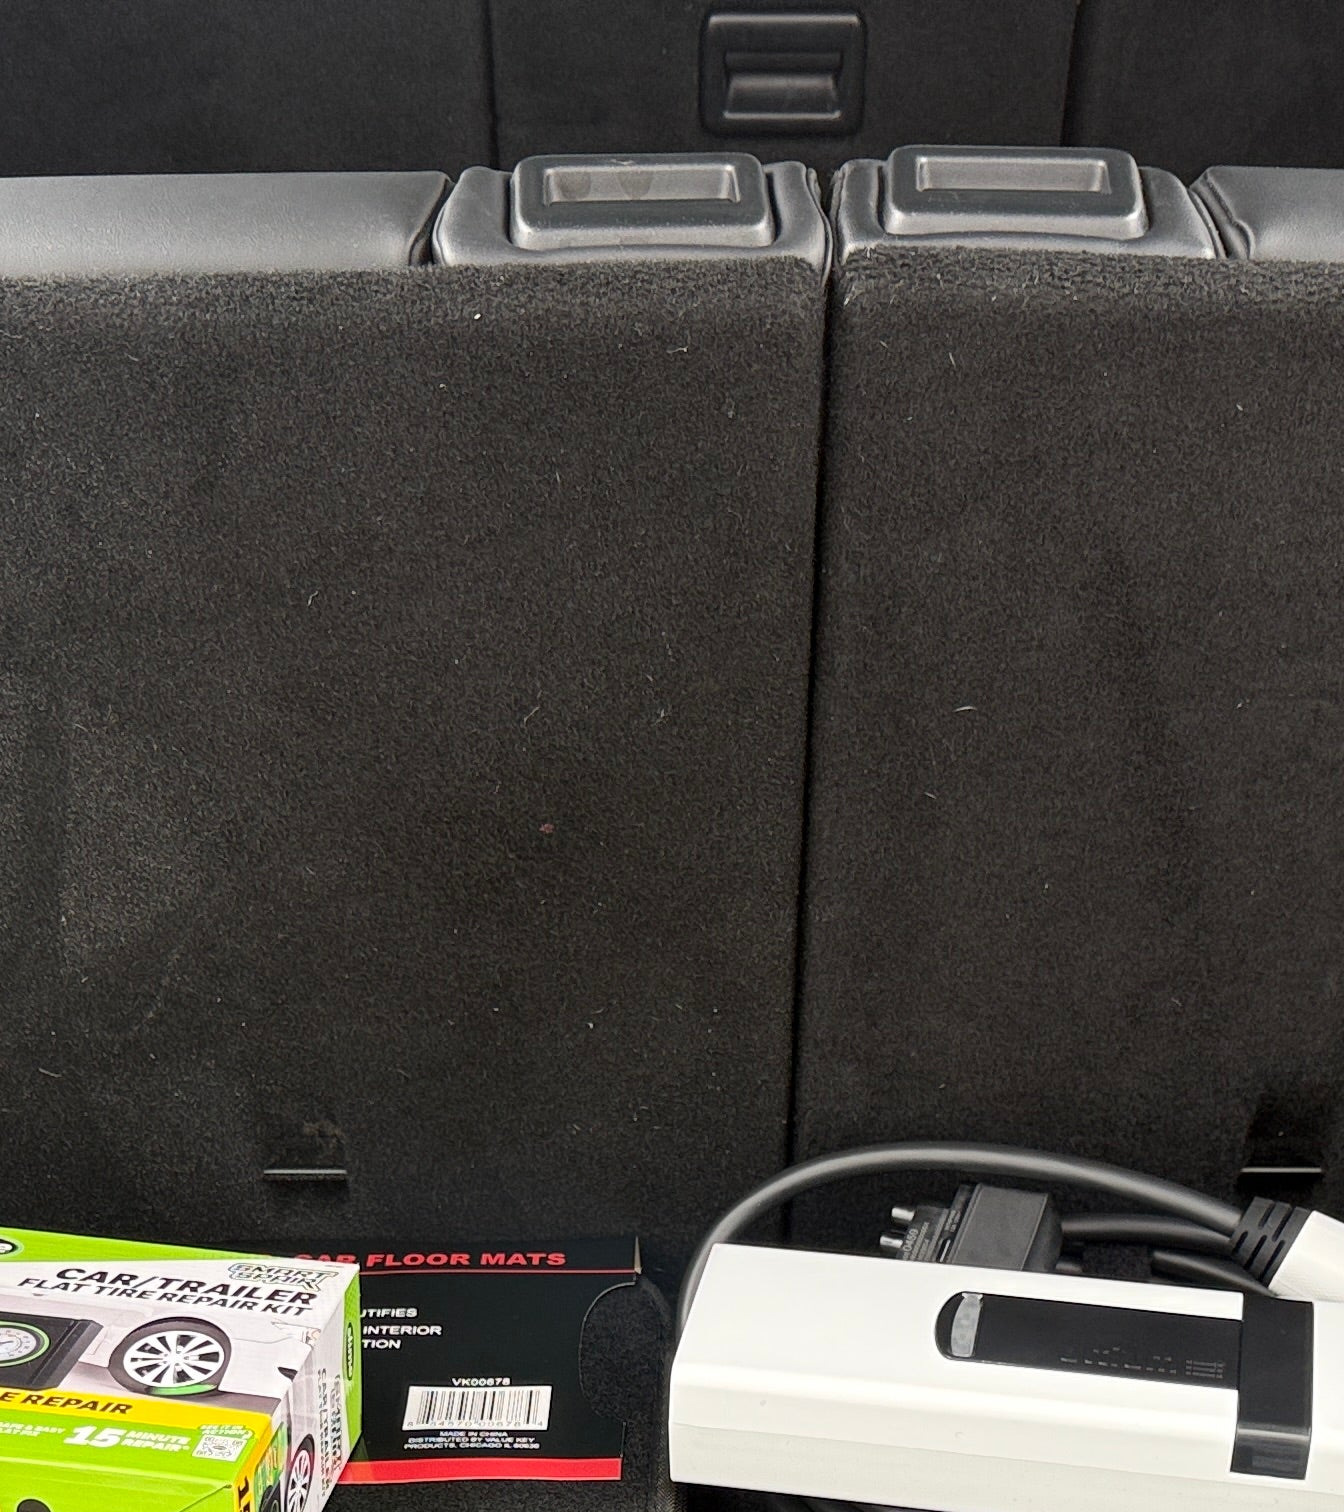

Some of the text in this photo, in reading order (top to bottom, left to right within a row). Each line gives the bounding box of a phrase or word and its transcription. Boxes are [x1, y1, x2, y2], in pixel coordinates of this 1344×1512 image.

[366, 1253, 471, 1267] FLOOR
[479, 1252, 566, 1266] MATS
[228, 1263, 339, 1280] SMART
[55, 1268, 318, 1305] CAR/TRAILER
[17, 1277, 313, 1317] FLAT TIRE REPAIR KIT
[363, 1325, 443, 1336] INTERIOR
[451, 1377, 511, 1386] VK00678
[20, 1392, 134, 1415] REPAIR
[63, 1425, 191, 1448] 15 MINUTE
